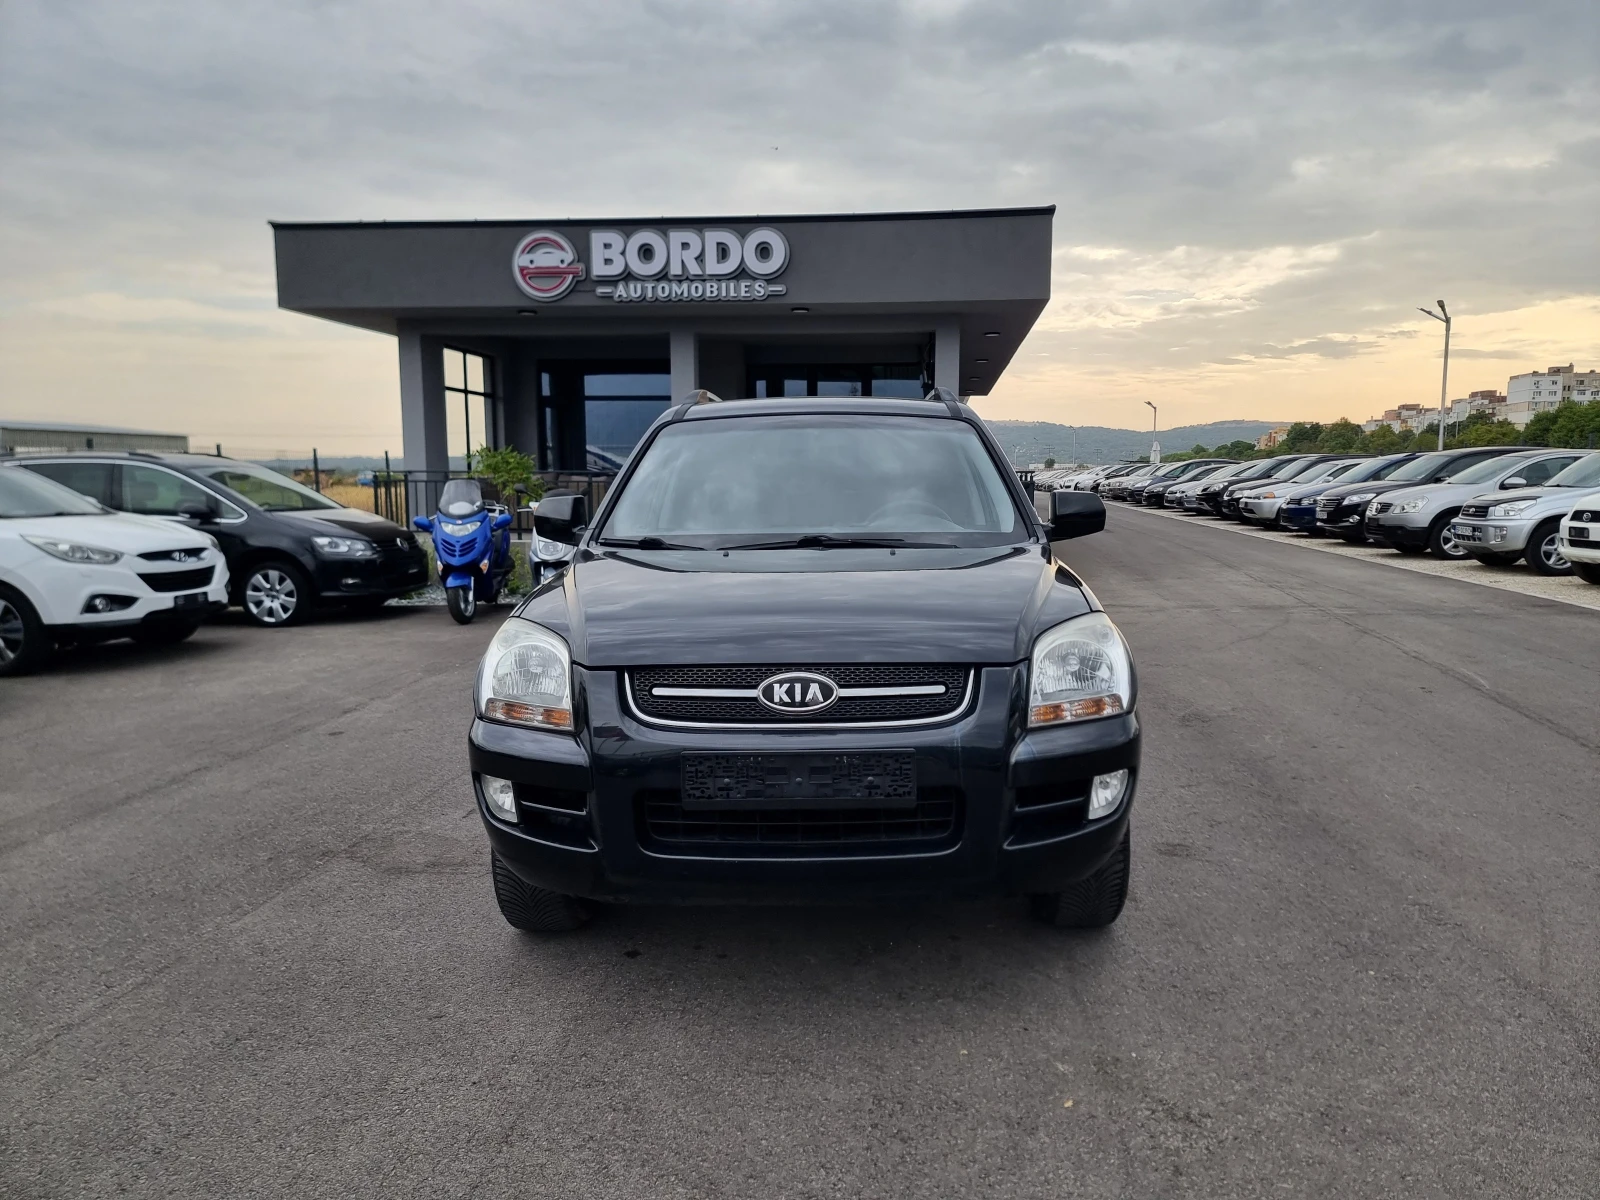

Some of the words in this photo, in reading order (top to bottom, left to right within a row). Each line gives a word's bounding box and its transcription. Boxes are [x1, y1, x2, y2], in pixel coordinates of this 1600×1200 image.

[591, 230, 787, 277] BORDO
[615, 281, 766, 298] AUTOMOBILES
[773, 683, 824, 703] KIA
